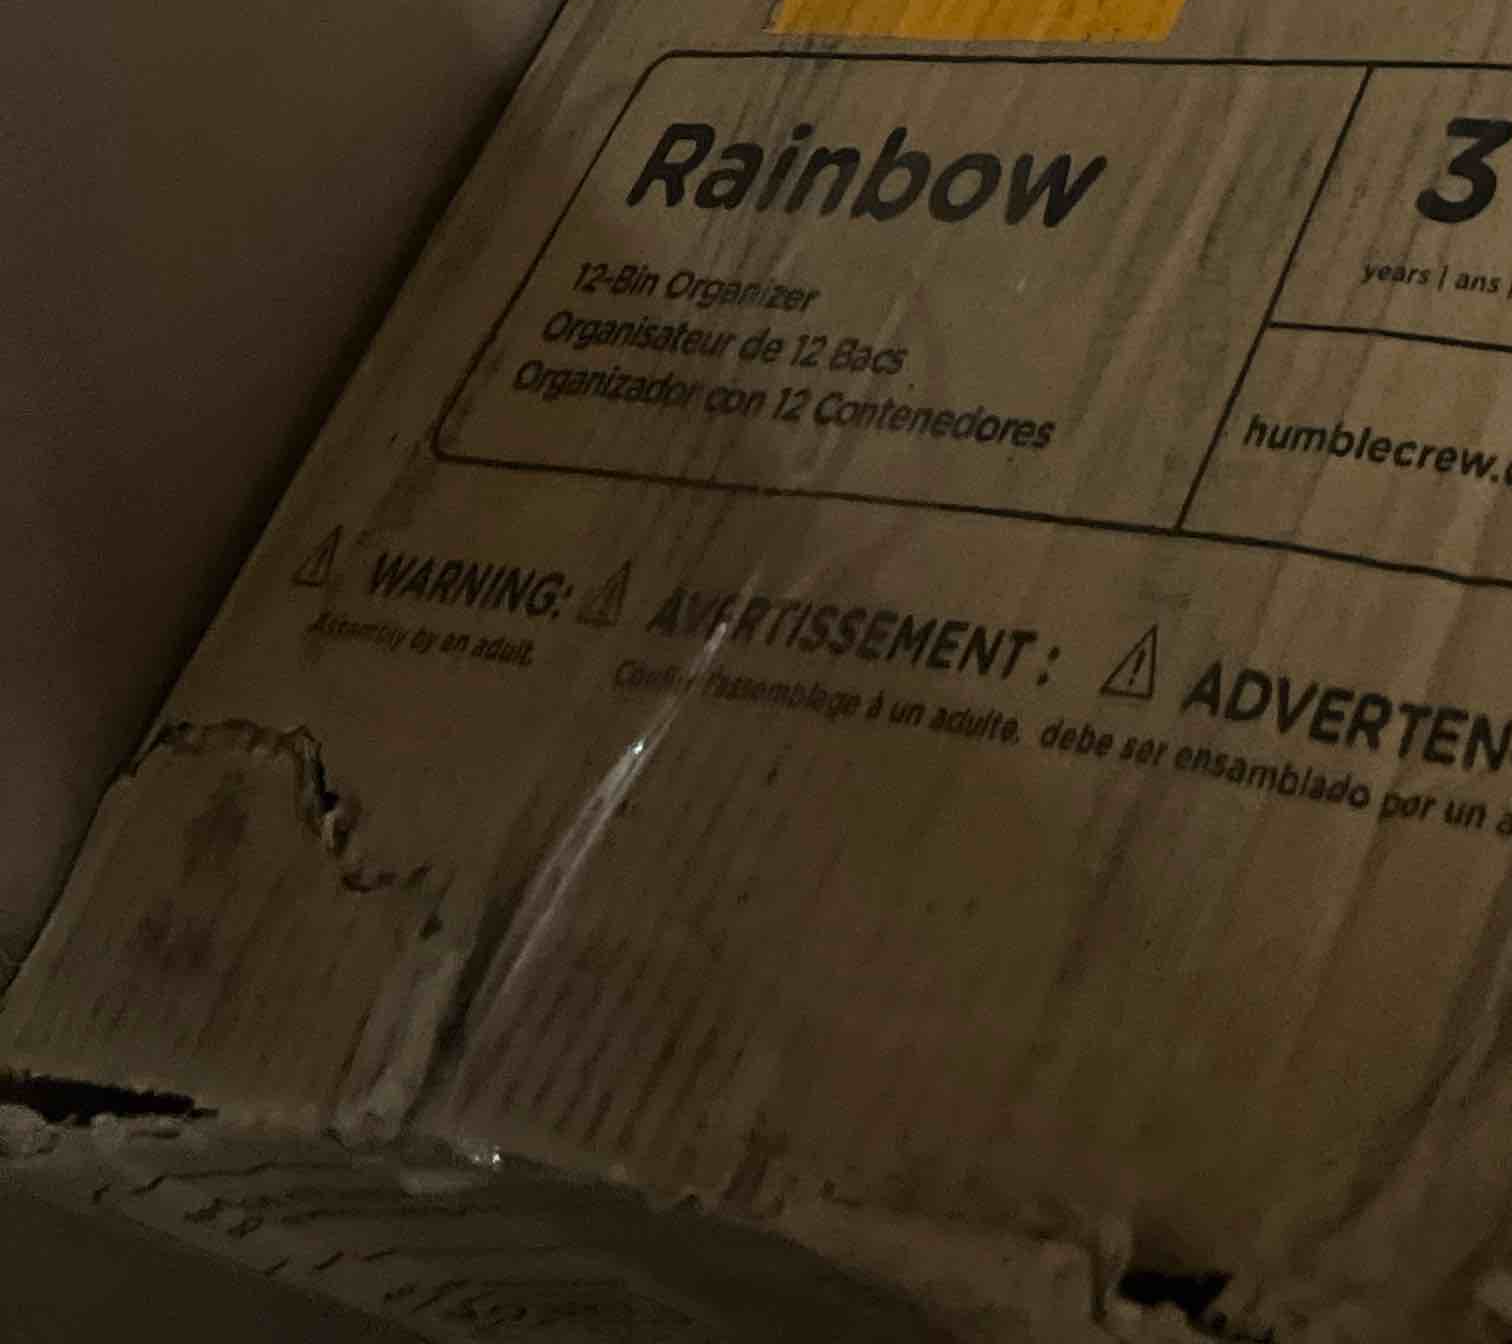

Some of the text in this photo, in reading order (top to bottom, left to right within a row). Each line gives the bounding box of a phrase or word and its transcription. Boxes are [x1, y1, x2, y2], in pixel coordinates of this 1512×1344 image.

[625, 123, 1108, 228] Rainbow
[573, 261, 821, 313] 12-Bin Organizer
[1361, 262, 1432, 286] years
[1454, 271, 1502, 294] ans
[541, 311, 909, 377] Organisateur de 12 Bacs
[513, 359, 1057, 450] Organizador con 12 Contenedores
[367, 550, 574, 622] WARNING:
[888, 701, 923, 726] un
[1039, 717, 1113, 757] debe
[1120, 734, 1168, 767] ser
[1174, 743, 1371, 809] ensamblado
[1377, 790, 1437, 822] por
[1444, 799, 1487, 828] un
